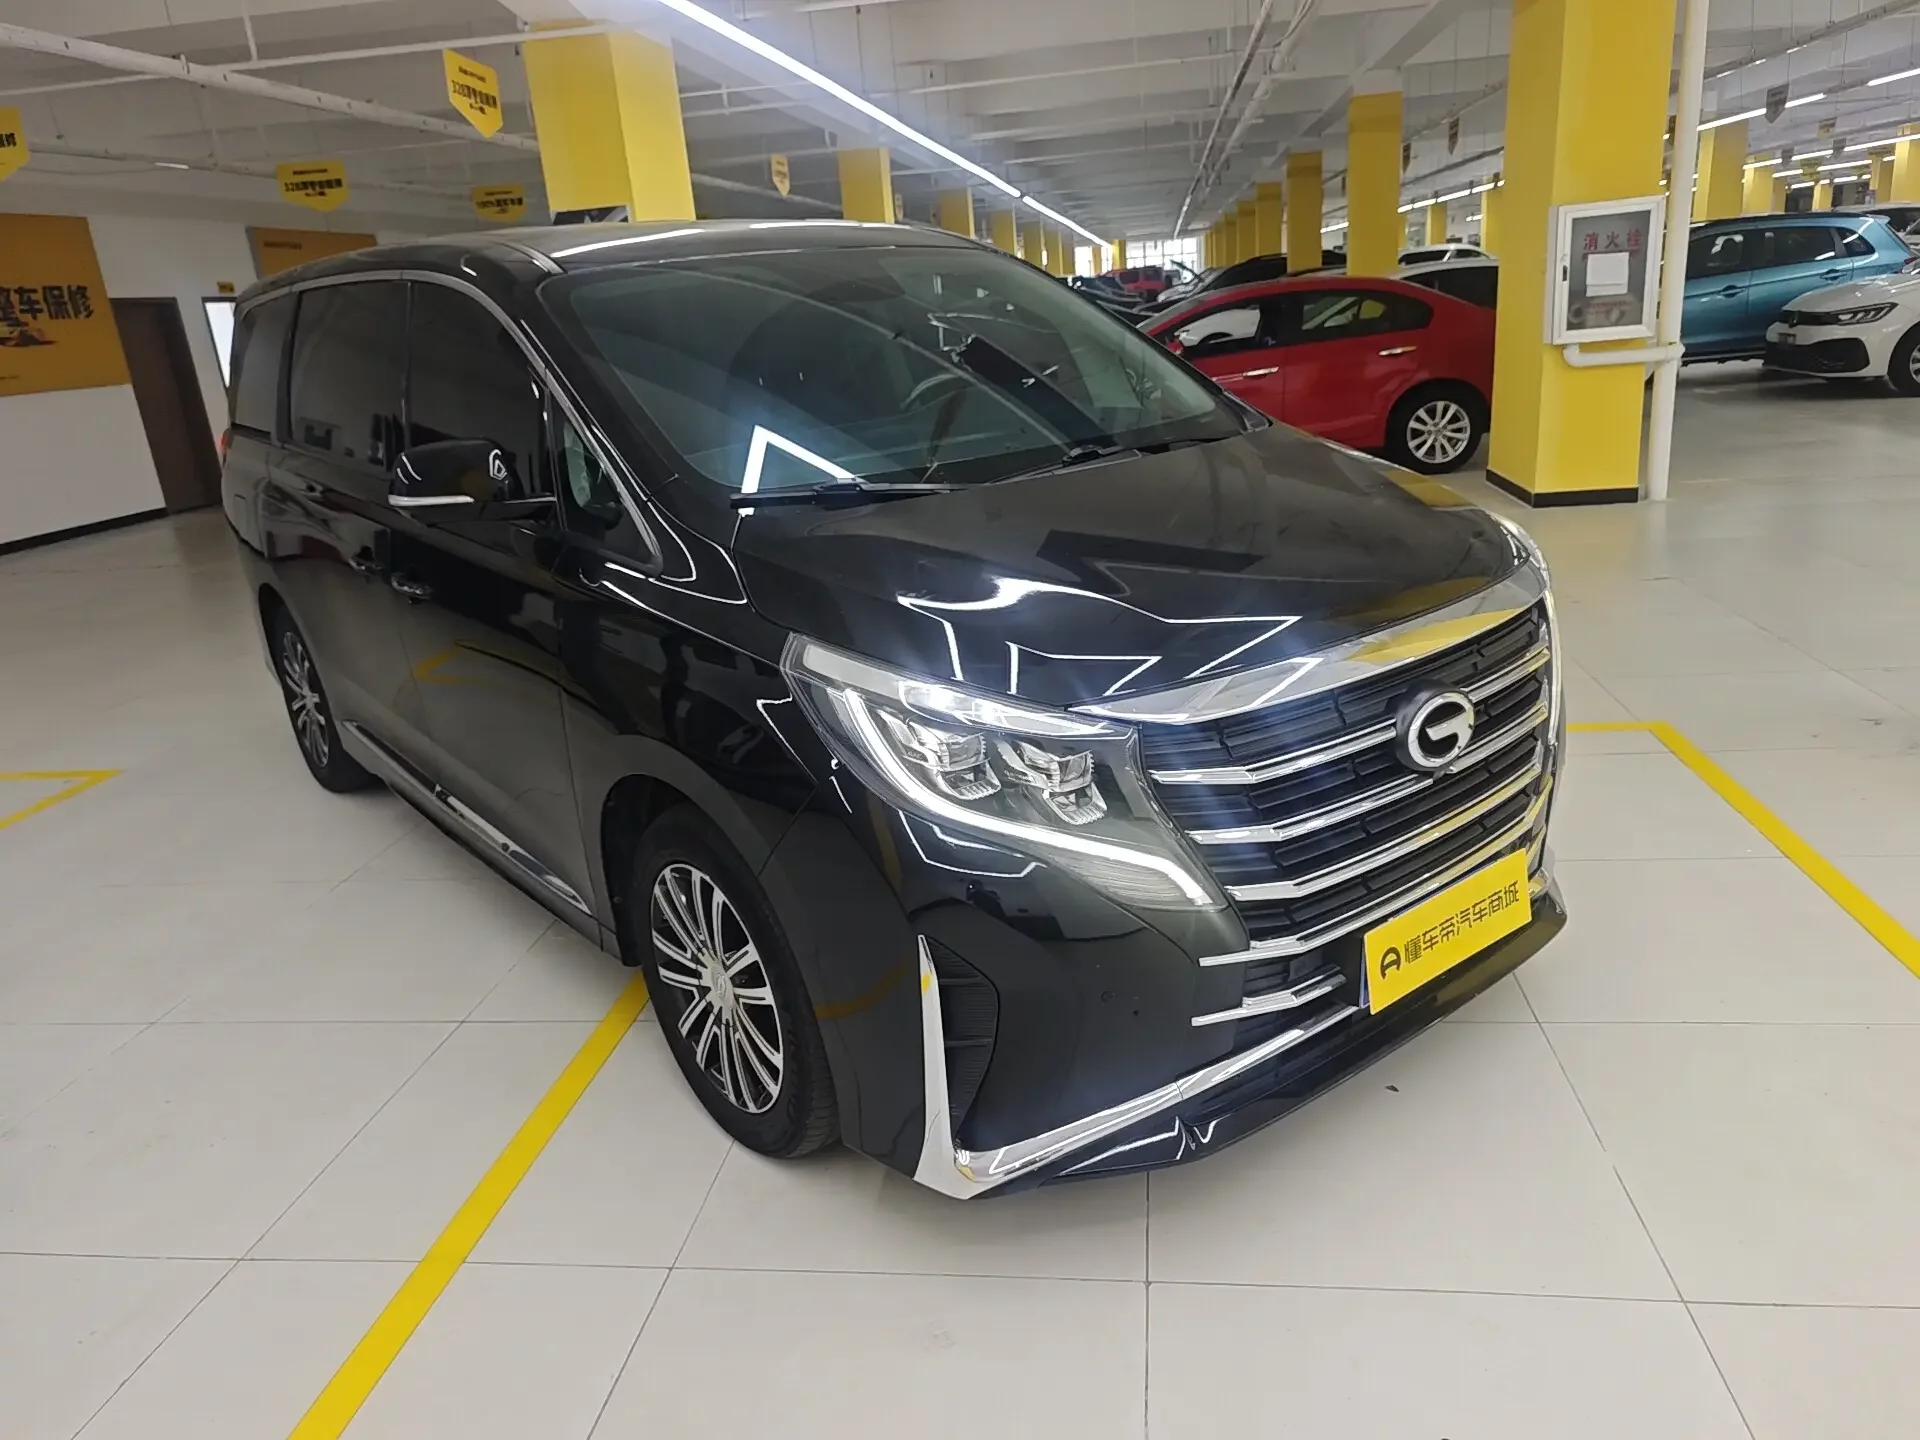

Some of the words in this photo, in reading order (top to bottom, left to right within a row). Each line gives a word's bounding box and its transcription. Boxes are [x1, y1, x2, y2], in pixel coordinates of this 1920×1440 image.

[1584, 229, 1643, 250] 消火栓
[1404, 880, 1520, 964] 懂车帝汽车商城
